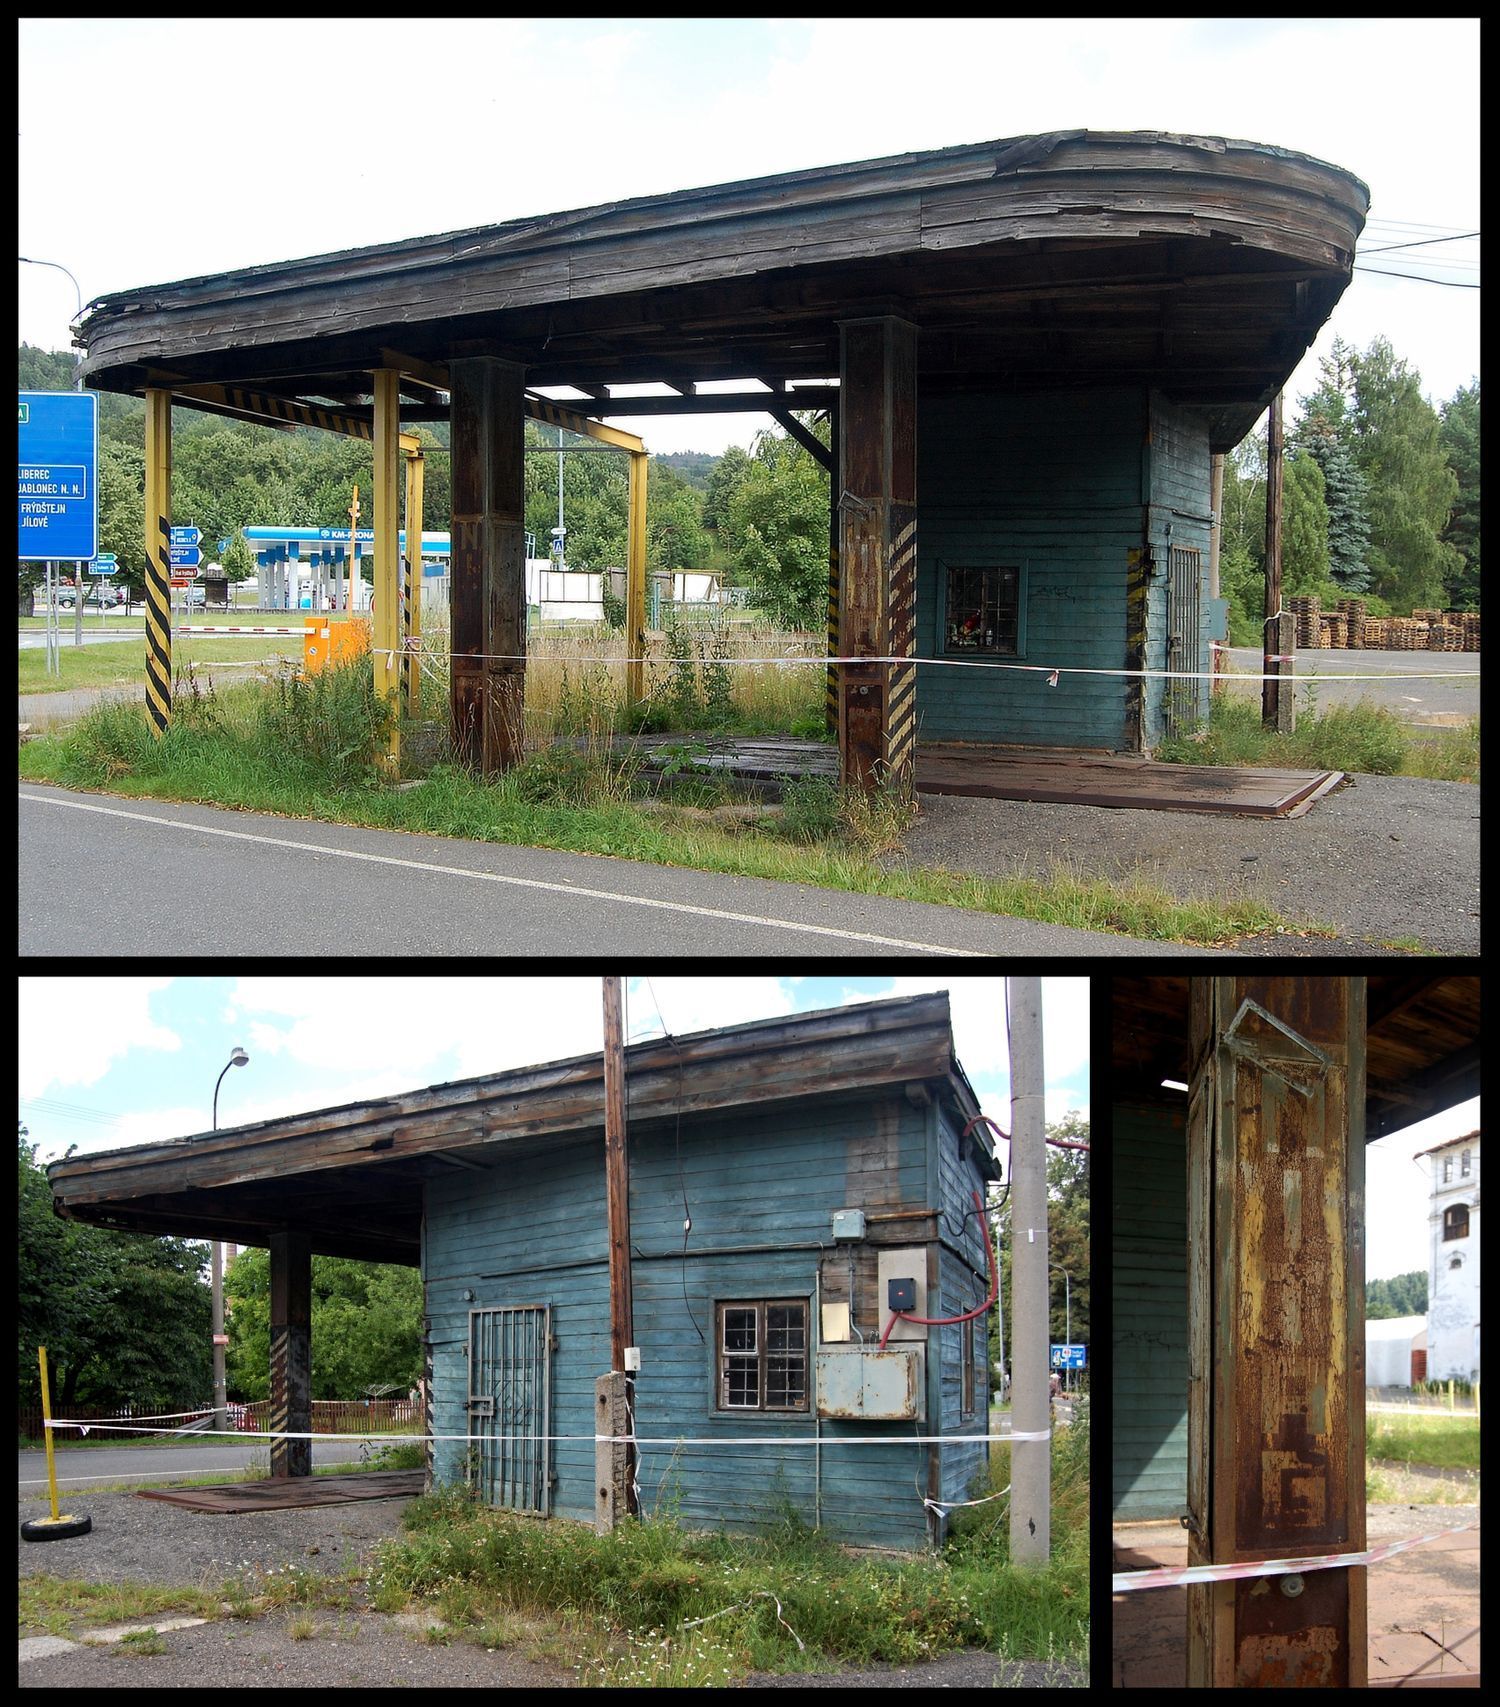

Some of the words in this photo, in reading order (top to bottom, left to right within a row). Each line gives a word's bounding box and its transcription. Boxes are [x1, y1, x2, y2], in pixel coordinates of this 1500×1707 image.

[18, 469, 50, 480] LIBEREC
[18, 483, 58, 494] JABLONEC
[61, 484, 70, 494] N.
[72, 484, 81, 494] N.
[21, 502, 66, 514] FRÝDŠTEJN
[21, 515, 49, 528] JÍLOVÉ
